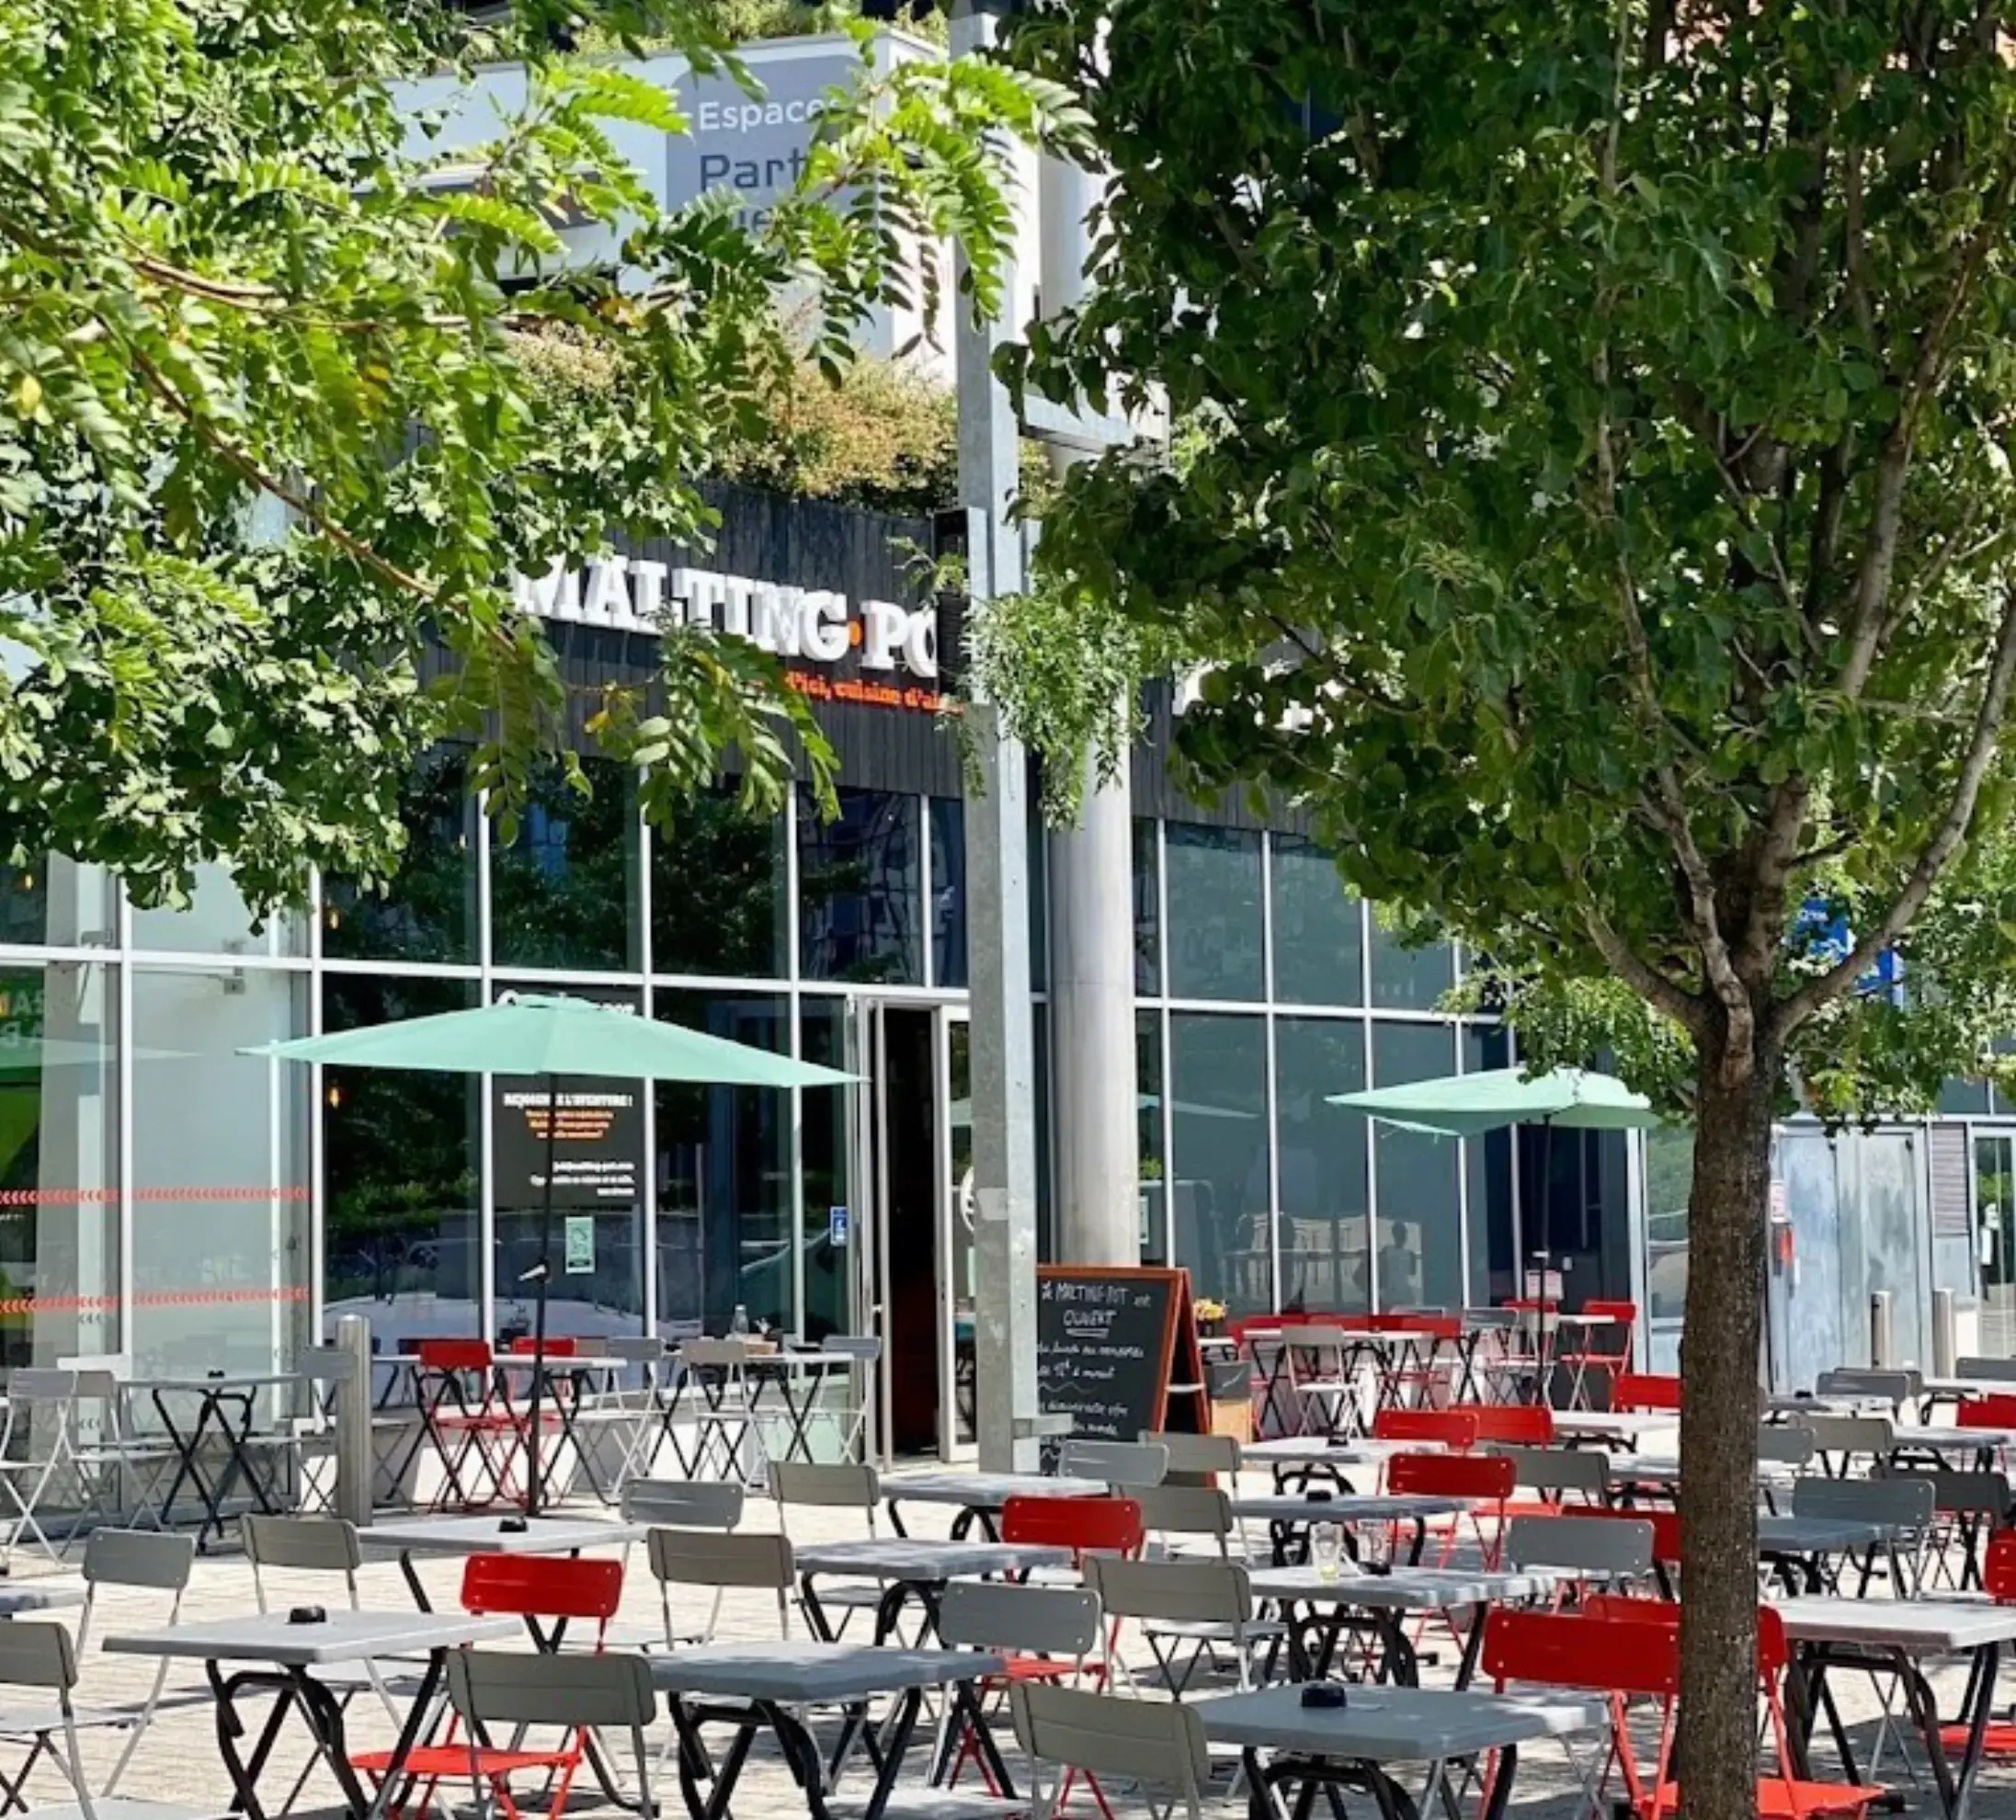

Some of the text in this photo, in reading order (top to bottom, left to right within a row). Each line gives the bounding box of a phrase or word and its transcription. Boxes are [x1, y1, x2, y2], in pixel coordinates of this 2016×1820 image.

[860, 599, 937, 677] PO
[833, 678, 901, 705] cuisine
[1063, 1309, 1118, 1326] OUVERT
